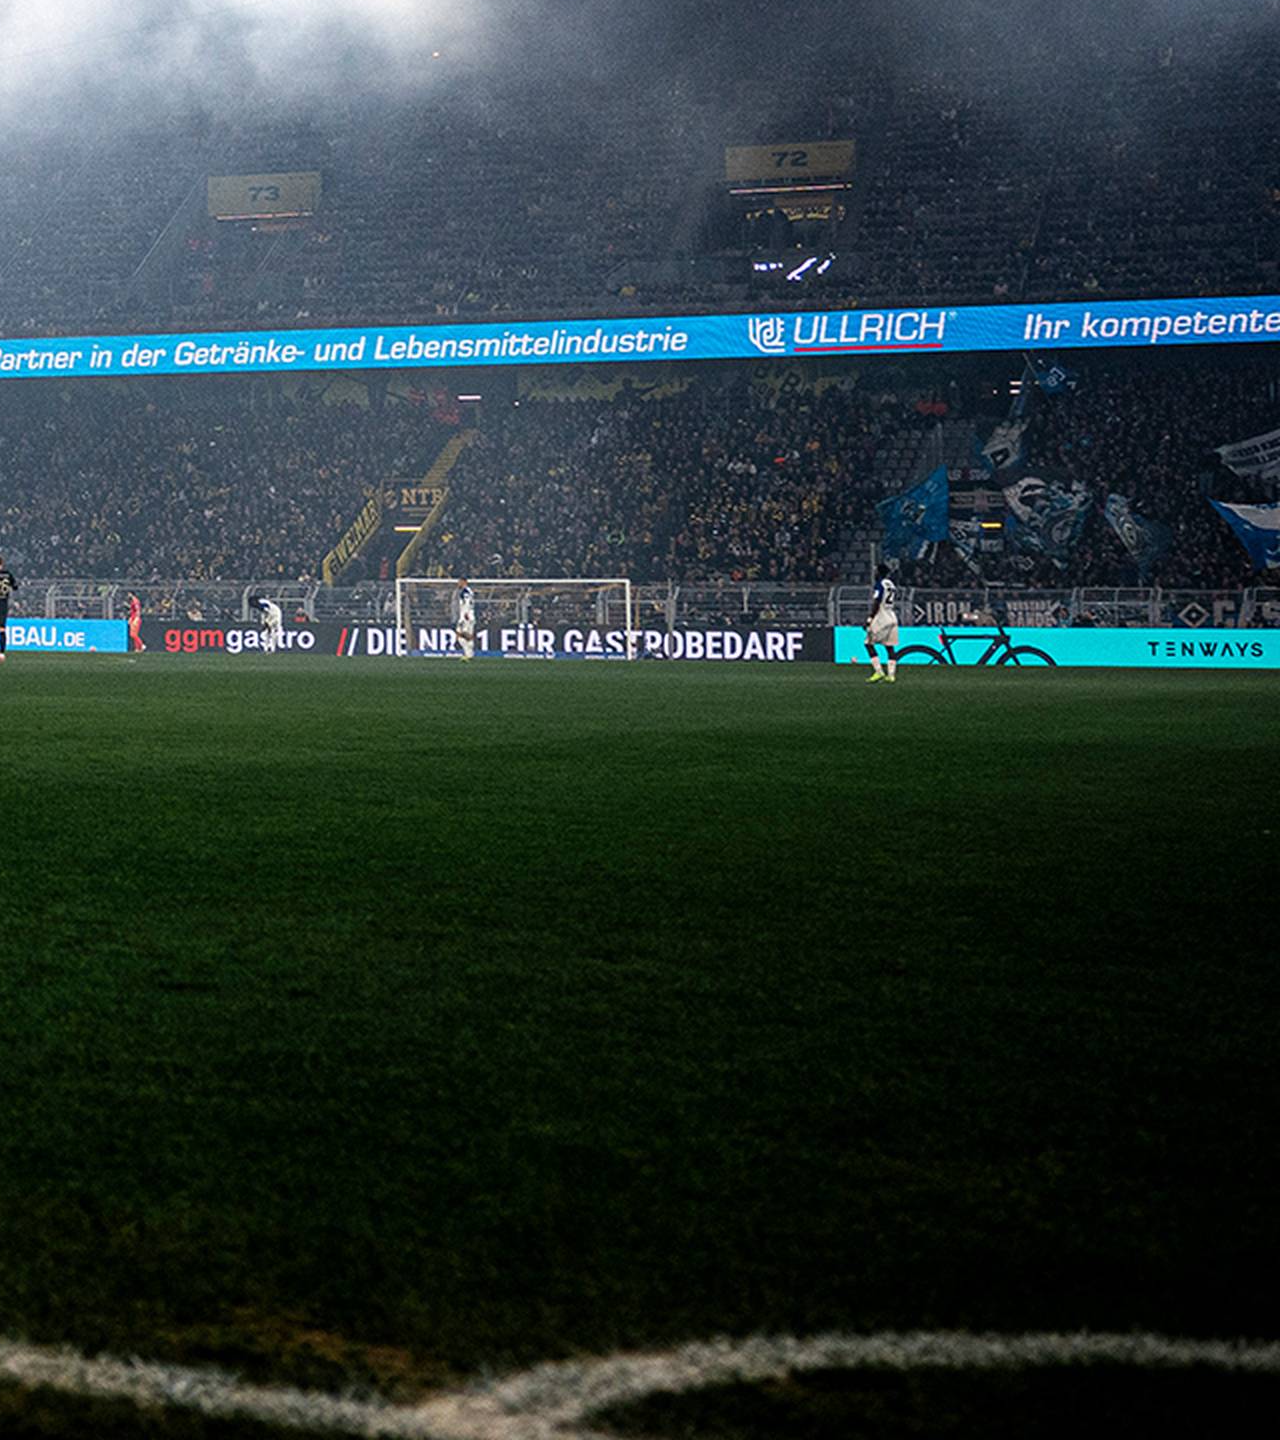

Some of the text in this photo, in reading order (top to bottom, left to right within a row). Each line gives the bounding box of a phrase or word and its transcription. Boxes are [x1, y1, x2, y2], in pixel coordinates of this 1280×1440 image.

[772, 150, 807, 168] 72
[248, 185, 280, 202] 73
[793, 311, 946, 345] ULLRICH
[1023, 313, 1070, 340] Ihr
[90, 344, 112, 368] in
[121, 342, 158, 367] der
[174, 339, 305, 367] Getränke-
[313, 336, 367, 362] und
[374, 326, 688, 361] Lebensmittelindustrie
[366, 627, 408, 656] DIE
[476, 629, 488, 650] 1
[501, 623, 555, 658] FÜR
[1147, 641, 1264, 658] TENWAYS
